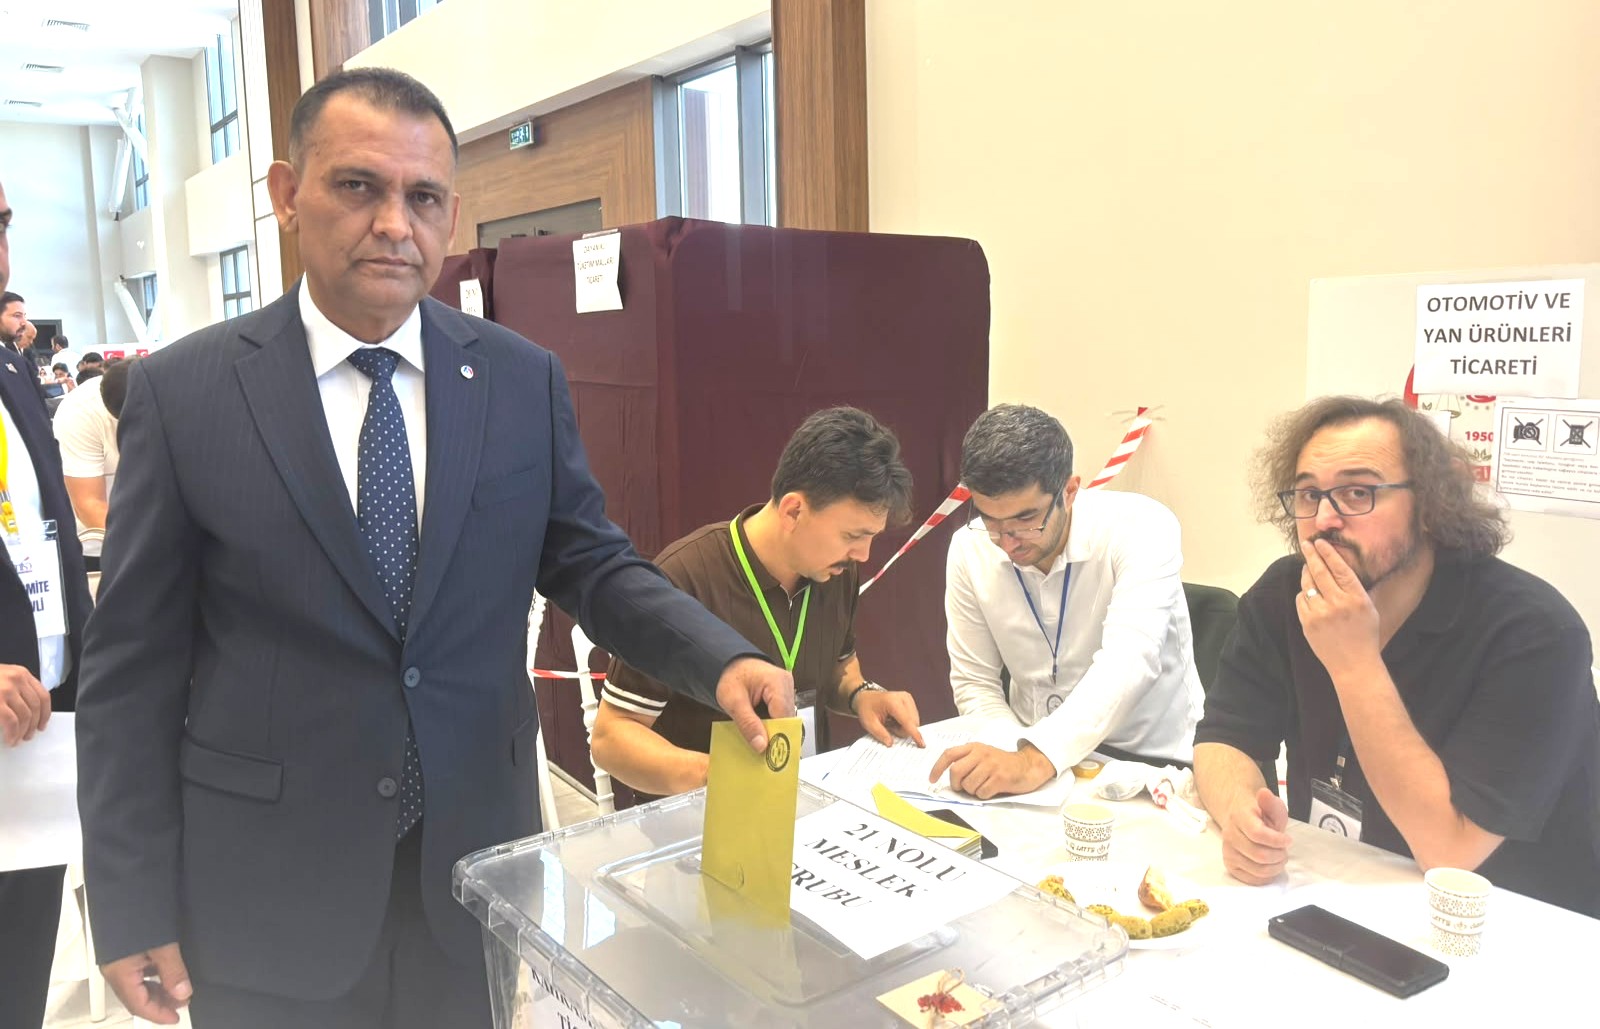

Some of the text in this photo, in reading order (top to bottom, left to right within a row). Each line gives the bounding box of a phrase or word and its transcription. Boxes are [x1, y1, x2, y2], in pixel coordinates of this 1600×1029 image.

[1426, 290, 1571, 313] OTOMOTİV VE
[1423, 322, 1572, 344] YAN ÜRÜNLERİ
[1450, 355, 1538, 375] TİCARETİ
[1465, 431, 1494, 442] 1950
[843, 823, 967, 882] 21 NOLU
[804, 838, 929, 898] MESLEK
